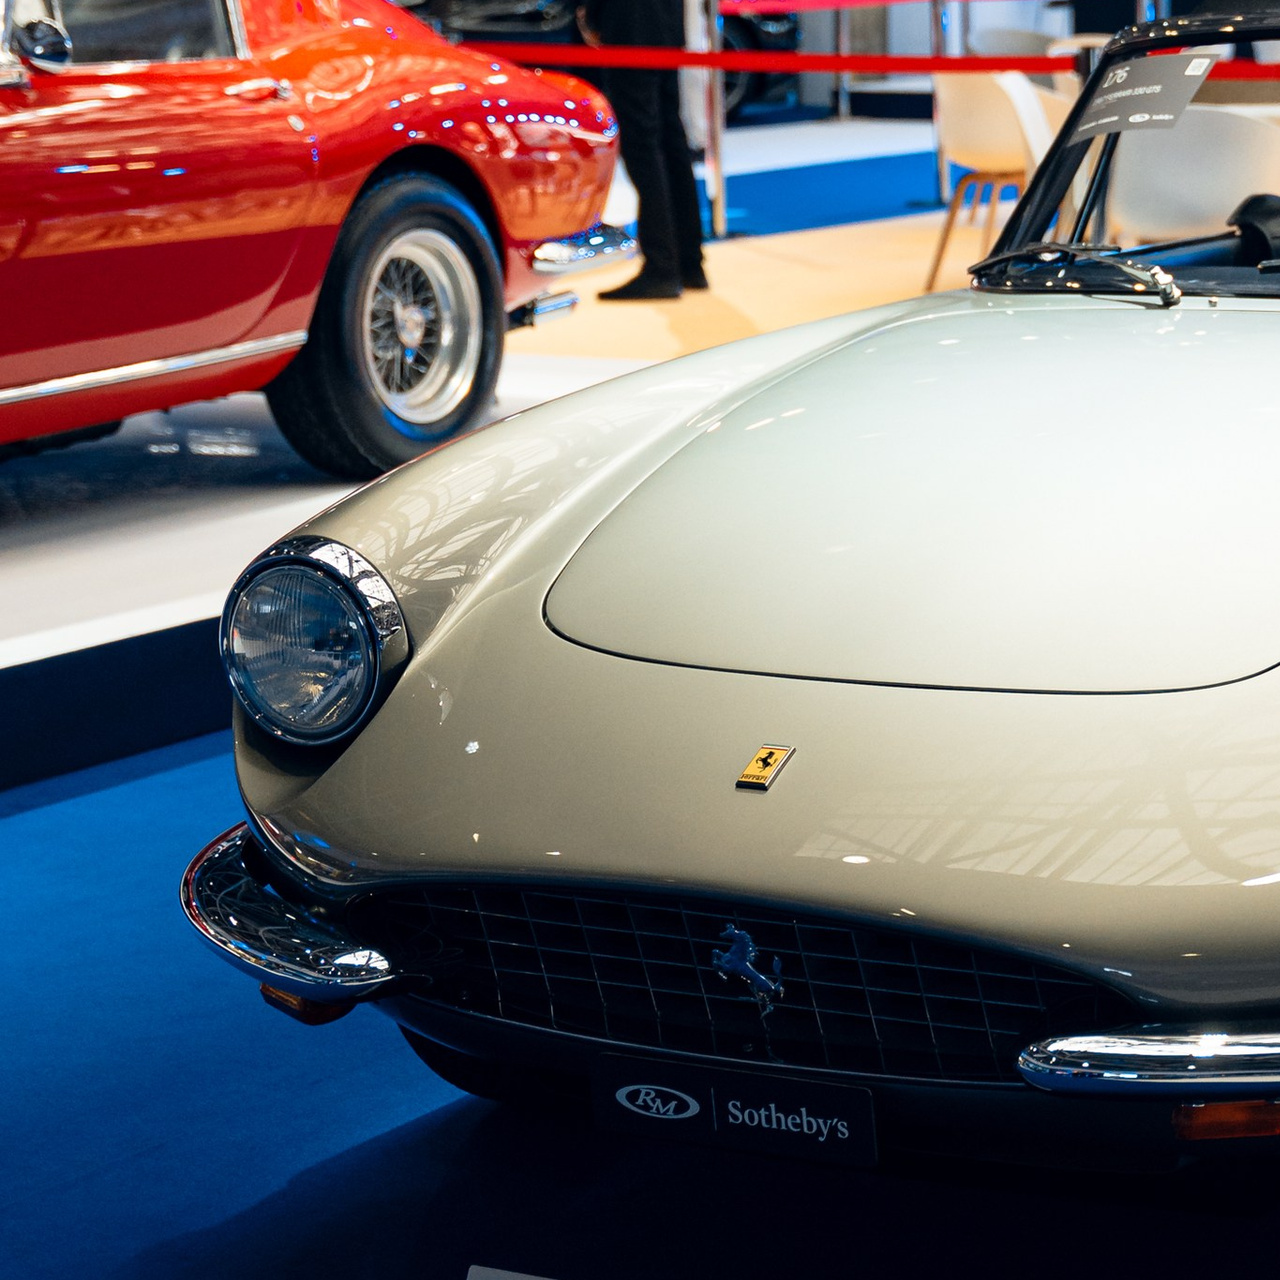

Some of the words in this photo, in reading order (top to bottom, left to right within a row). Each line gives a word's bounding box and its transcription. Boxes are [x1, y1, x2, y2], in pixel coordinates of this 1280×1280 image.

[1102, 66, 1130, 88] 176
[635, 1088, 678, 1116] RM
[728, 1100, 849, 1141] Sotheby's
